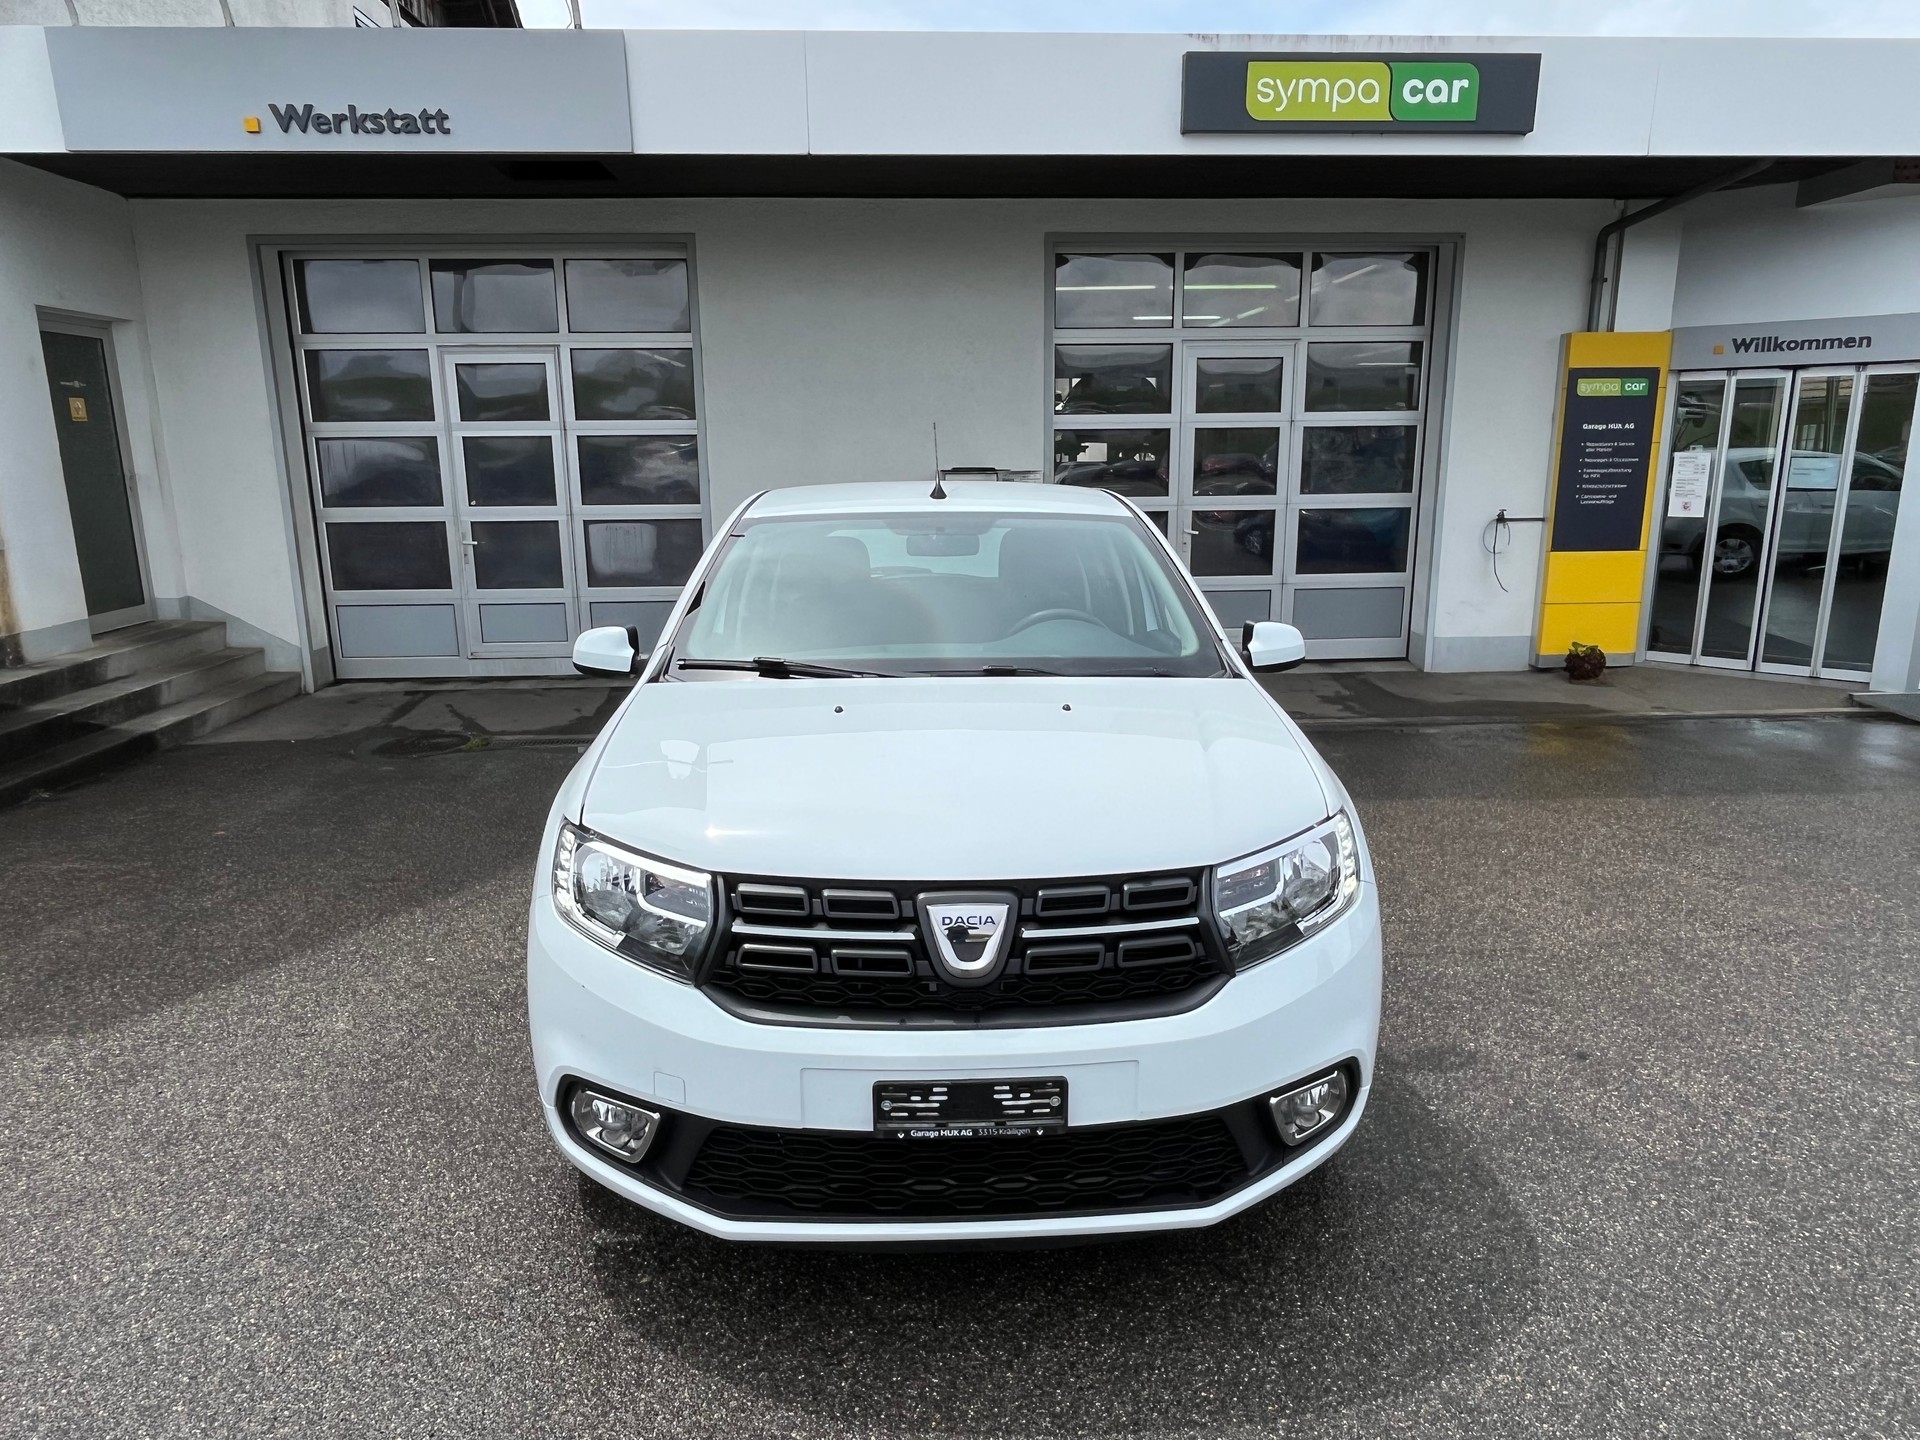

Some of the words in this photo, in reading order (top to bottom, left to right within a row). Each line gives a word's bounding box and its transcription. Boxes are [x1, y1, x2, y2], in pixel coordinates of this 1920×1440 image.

[1256, 77, 1380, 113] sympa
[1402, 78, 1469, 104] car
[267, 103, 451, 135] Werkstatt
[1731, 335, 1872, 354] Willkommen
[1580, 382, 1619, 394] sympa
[1624, 381, 1647, 391] car
[1582, 423, 1607, 431] Garage
[1624, 422, 1635, 430] AG
[941, 915, 996, 926] DACIA
[910, 1129, 939, 1138] Garage
[978, 1128, 998, 1136] 3315
